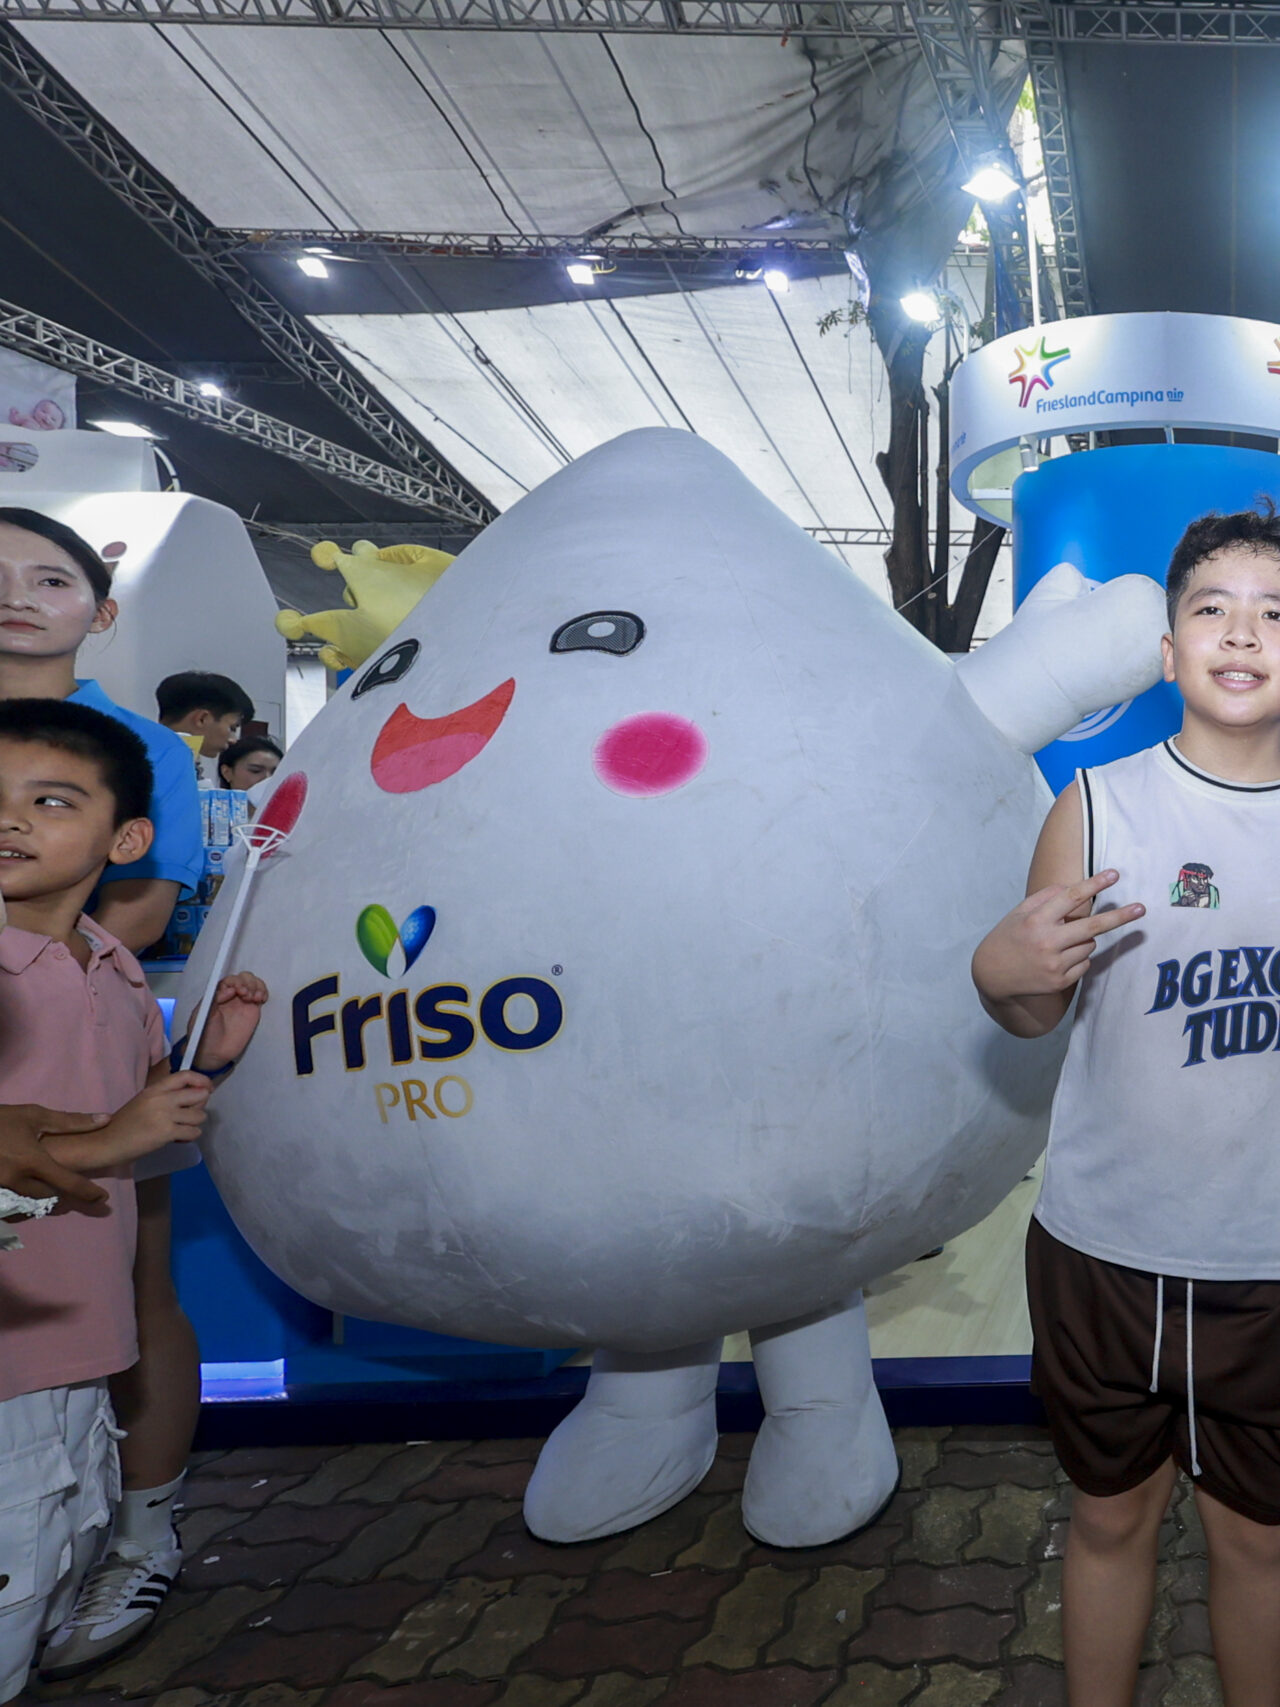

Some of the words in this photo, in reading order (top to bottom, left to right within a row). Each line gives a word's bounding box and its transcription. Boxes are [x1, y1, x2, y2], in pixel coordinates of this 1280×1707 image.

[1036, 390, 1163, 414] FrieslandCampina
[292, 972, 565, 1079] Friso
[373, 1074, 474, 1124] PRO
